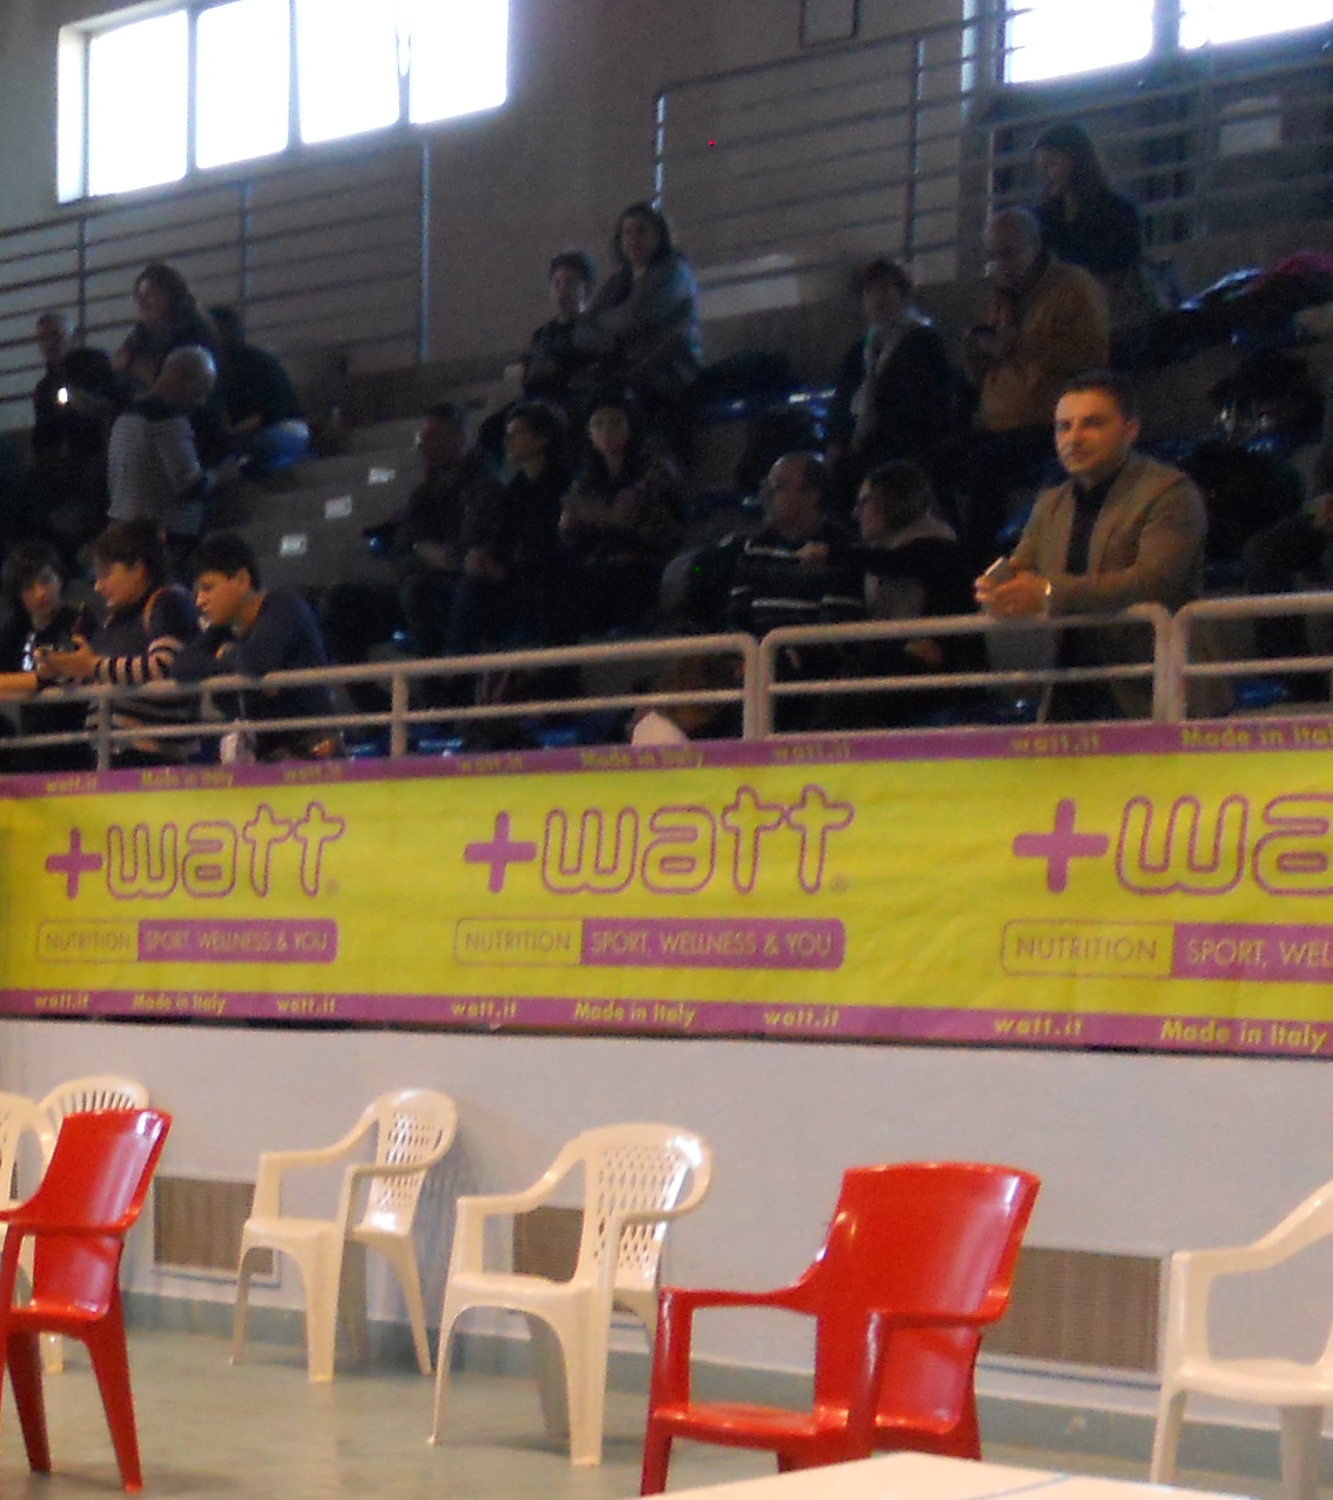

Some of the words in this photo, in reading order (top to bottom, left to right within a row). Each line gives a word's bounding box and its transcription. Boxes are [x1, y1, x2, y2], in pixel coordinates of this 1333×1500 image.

[1012, 733, 1102, 752] watt.it
[1183, 725, 1252, 746] Made
[1259, 724, 1282, 745] in
[45, 930, 130, 951] NUTRITION
[198, 930, 272, 951] WELLNESS
[276, 931, 288, 950] &
[292, 930, 328, 951] YOU
[464, 931, 572, 953] NUTRITION
[660, 931, 757, 955] WELLNESS
[764, 932, 779, 955] &
[786, 932, 832, 956] YOU
[1016, 936, 1158, 961] NUTRITION
[1186, 938, 1267, 968] SPORT,
[34, 993, 90, 1009] watt.it
[133, 993, 172, 1011] Made
[193, 993, 227, 1015] Italy
[276, 996, 337, 1014] watt.it
[451, 1001, 518, 1019] watt.it
[574, 1002, 625, 1022] Made
[631, 1003, 647, 1022] in
[653, 1003, 696, 1027] Italy
[764, 1007, 841, 1028] watt.it
[995, 1015, 1082, 1037] watt.it
[1160, 1019, 1230, 1043] Made
[1239, 1022, 1263, 1046] in
[1271, 1024, 1328, 1053] Italy
